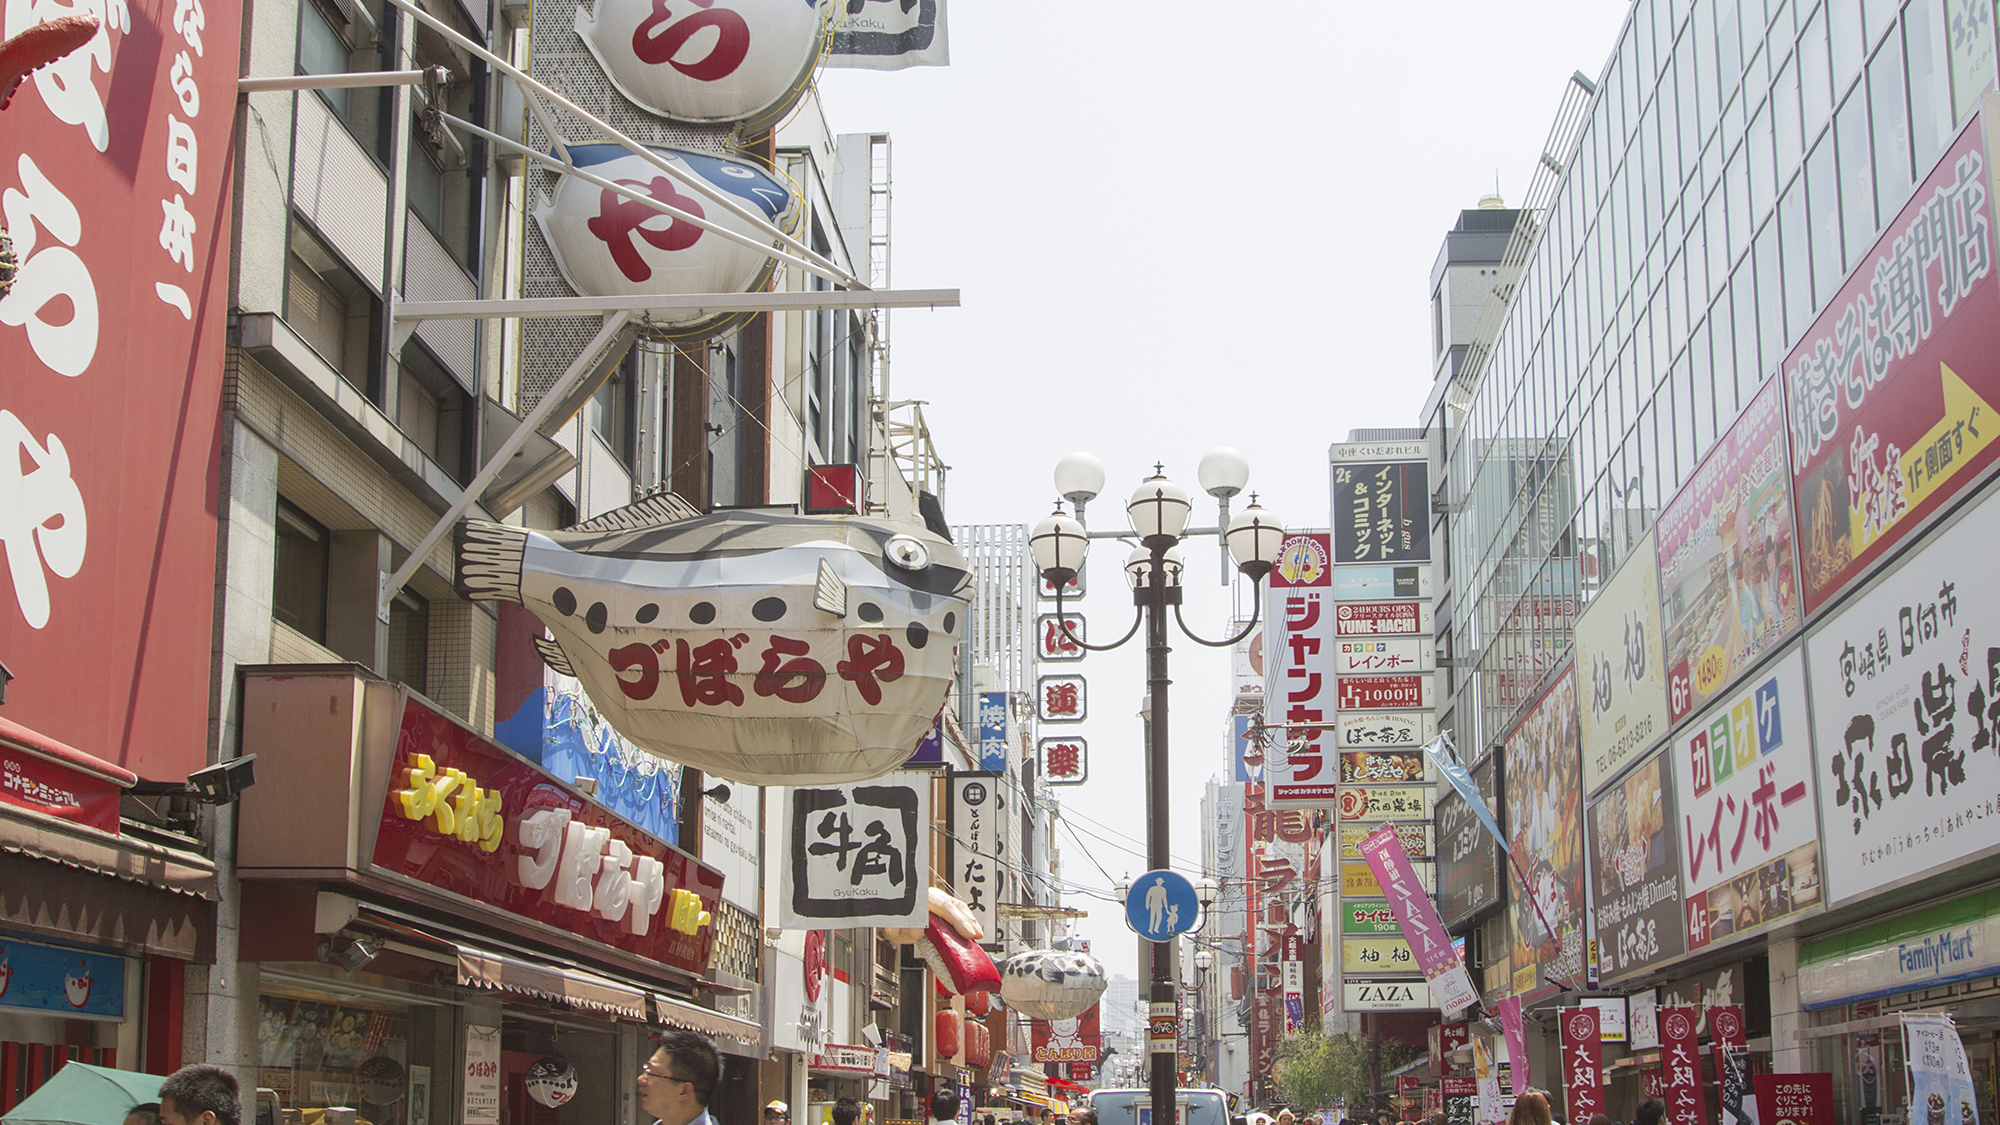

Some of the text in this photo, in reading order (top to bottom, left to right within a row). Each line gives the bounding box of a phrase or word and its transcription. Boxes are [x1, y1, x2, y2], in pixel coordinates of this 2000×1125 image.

[1789, 149, 1992, 475] 焼きそば専門店
[1695, 444, 1728, 499] SWEETS
[1737, 384, 1775, 446] GARDEN
[1338, 446, 1422, 458] 中座くいだおれビル
[1336, 467, 1351, 484] 2F
[1375, 465, 1394, 560] インターネット
[1422, 577, 1428, 585] 6
[1353, 604, 1415, 614] 24HOURS OPEN
[1423, 613, 1429, 622] 5
[1338, 618, 1416, 634] YUME-HACHI
[1839, 580, 1957, 698] 宮崎県 日向市
[1343, 643, 1386, 653] カラオケ
[1424, 650, 1430, 658] 4
[1349, 653, 1414, 669] レインボー
[607, 633, 906, 708] づぼらや
[1287, 593, 1323, 782] ジャンカラ
[1365, 688, 1418, 701] 1000円
[1426, 687, 1431, 696] 3
[1671, 674, 1689, 715] 6F
[980, 704, 1006, 760] 焼肉
[1346, 726, 1414, 744] ぼて茶屋
[1426, 724, 1432, 733] 3
[1596, 757, 1608, 776] TEL
[1608, 713, 1653, 761] 06-6213-8216
[1692, 690, 1777, 791] カラオケ
[1427, 761, 1433, 770] 3
[1686, 760, 1807, 885] レインボー
[808, 811, 904, 887] 牛角
[518, 806, 664, 937] づぼらや
[1689, 901, 1707, 943] 4F
[1898, 928, 1974, 975] FamilyMart
[1358, 986, 1415, 1002] ZAZA
[1775, 1083, 1811, 1094] この先に
[1775, 1095, 1813, 1106] ぐりこ・や
[1775, 1106, 1814, 1117] あります!
